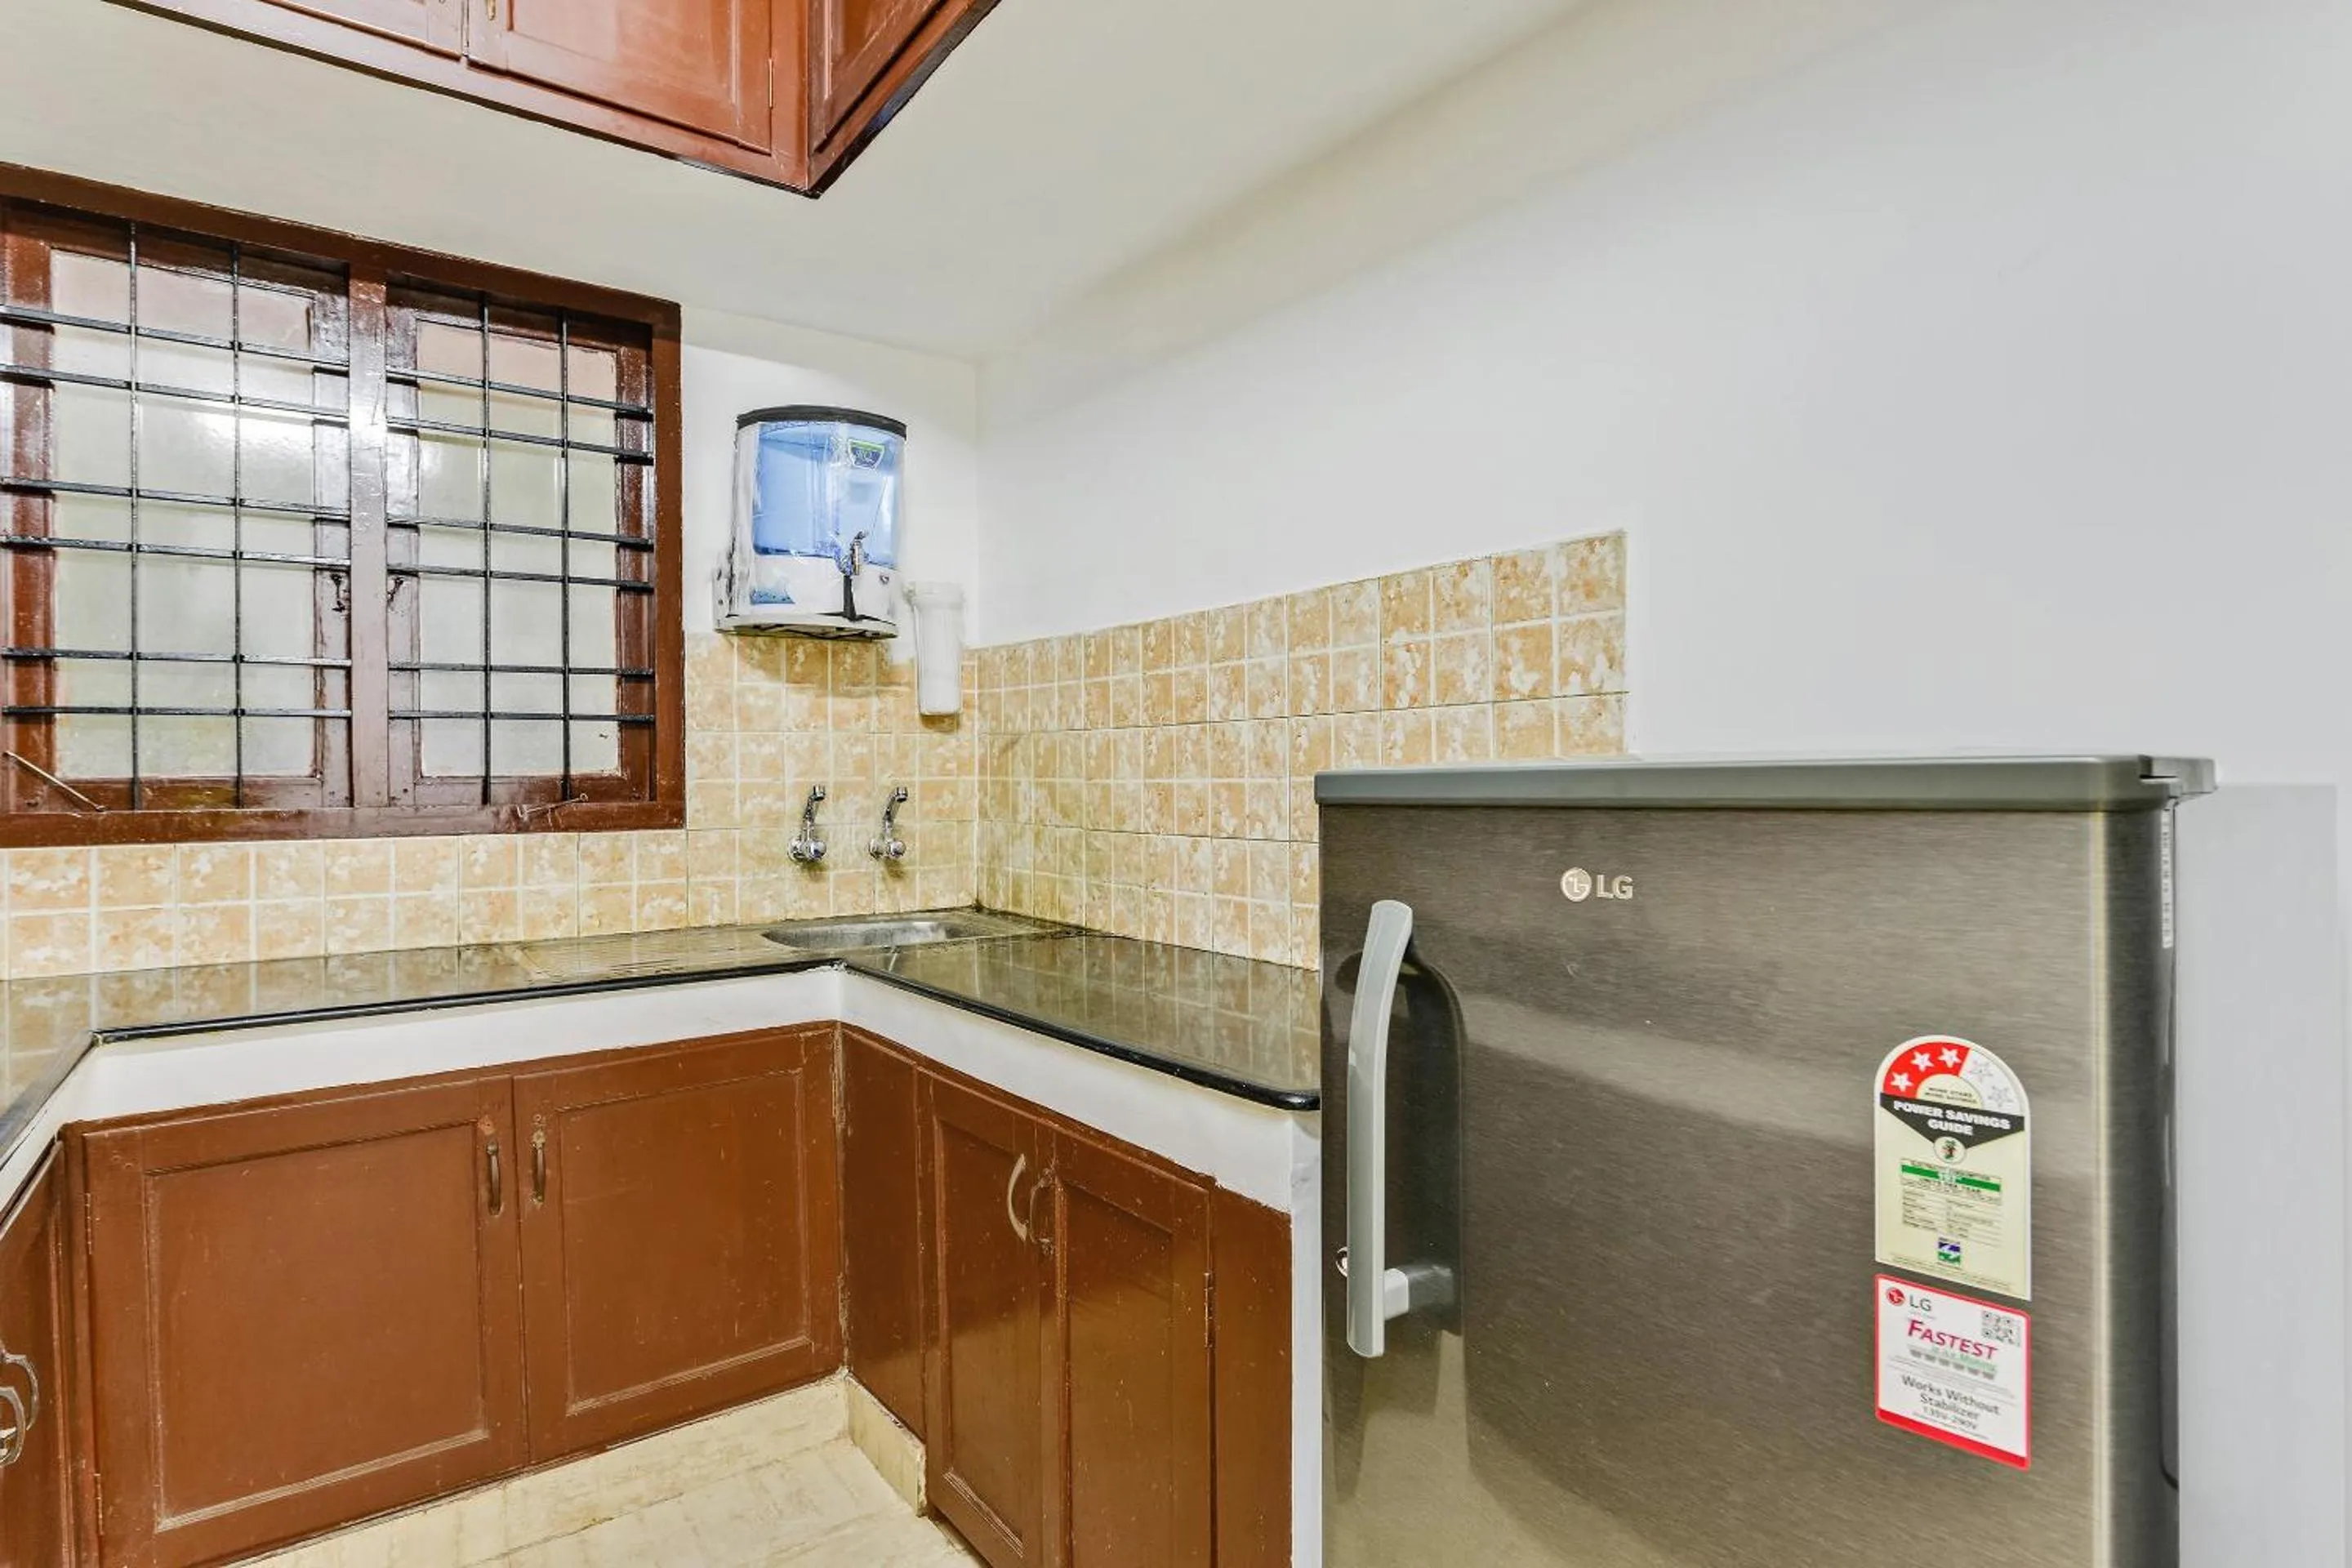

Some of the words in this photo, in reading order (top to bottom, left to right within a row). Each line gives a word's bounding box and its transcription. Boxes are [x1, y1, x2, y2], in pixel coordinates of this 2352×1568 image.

[1597, 875, 1633, 899] LG
[1893, 1100, 1943, 1118] POWER
[1945, 1110, 2011, 1129] SAVINGS
[1927, 1119, 1973, 1135] GUIDE
[1909, 1295, 1932, 1312] LG
[1907, 1319, 1998, 1359] FASTEST
[1902, 1374, 1942, 1396] Works
[1945, 1389, 1999, 1414] Without
[1921, 1392, 1980, 1419] Stabilizer
